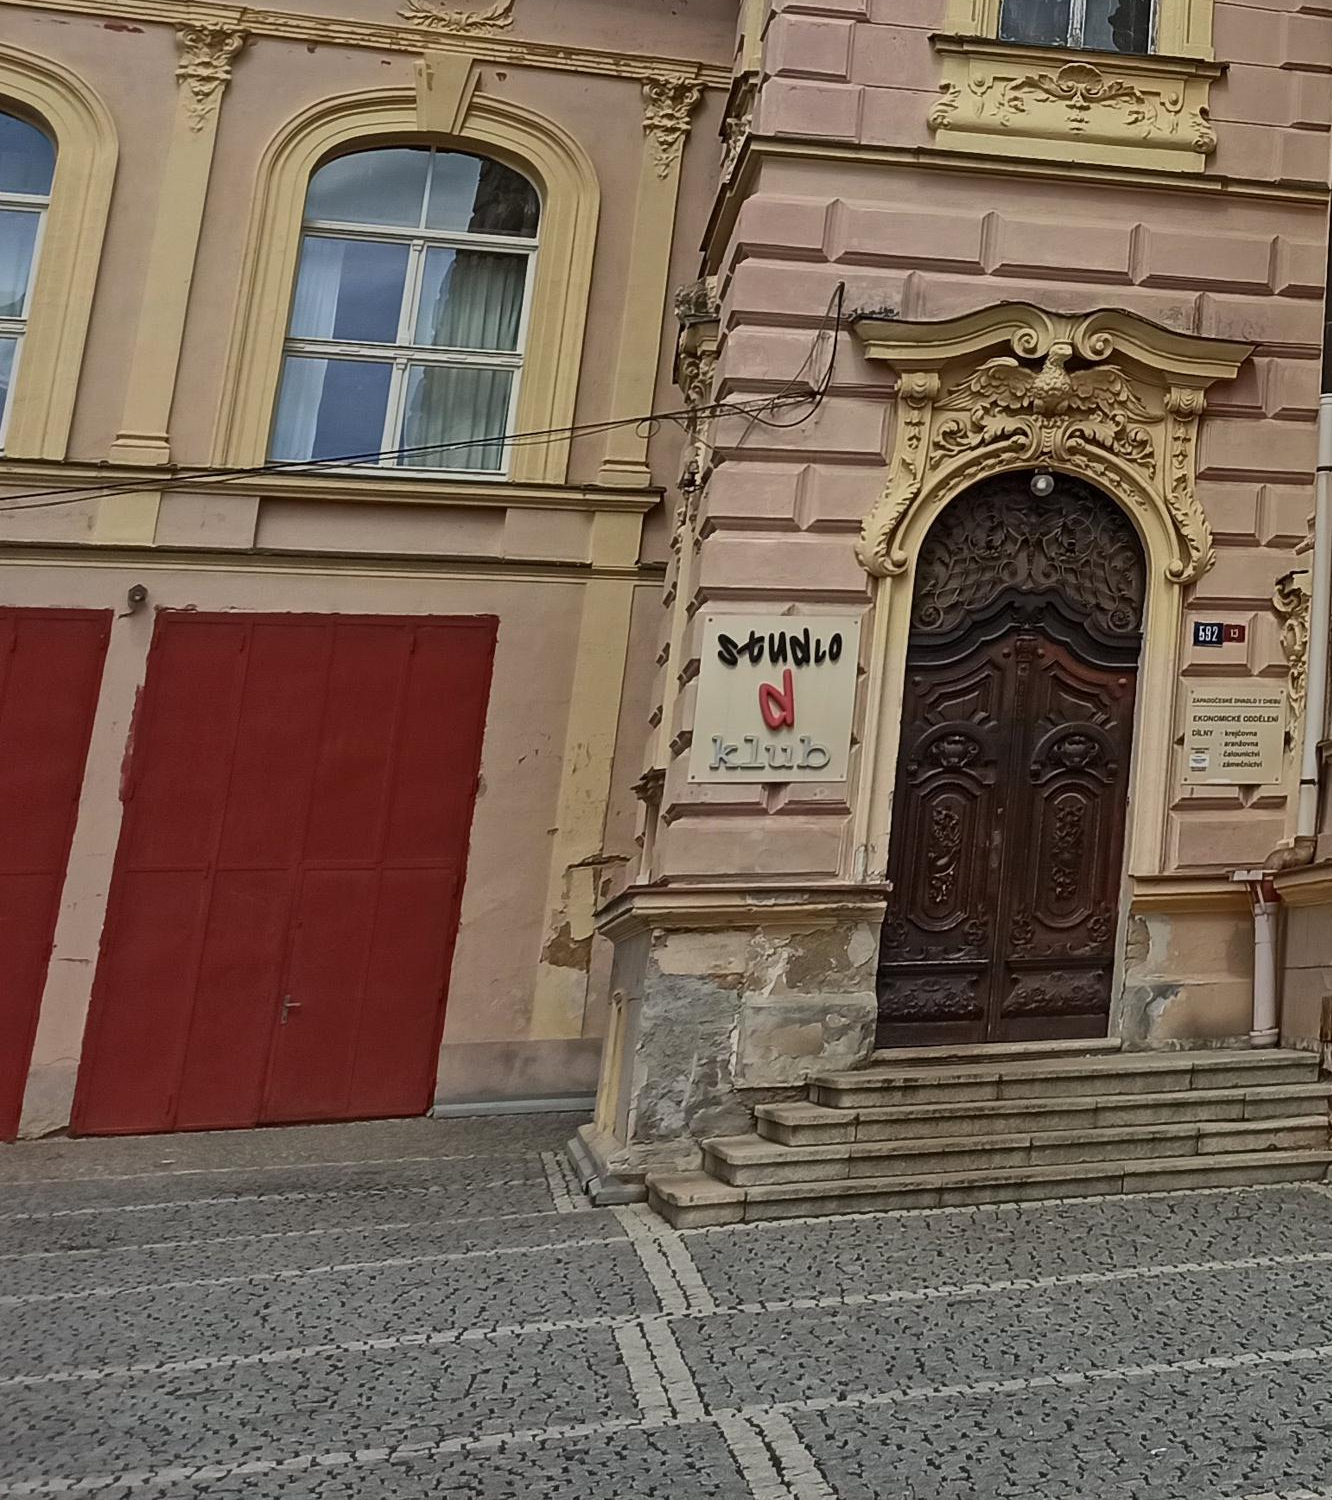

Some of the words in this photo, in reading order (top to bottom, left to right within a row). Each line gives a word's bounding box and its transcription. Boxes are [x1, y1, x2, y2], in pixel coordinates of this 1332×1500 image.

[1198, 625, 1219, 641] 592
[717, 627, 842, 666] studio
[759, 668, 795, 731] d
[1193, 714, 1241, 722] EKONOMICKÉ
[1192, 728, 1214, 736] DÍLNY
[1224, 739, 1259, 747] aranžovna
[709, 734, 831, 770] klub
